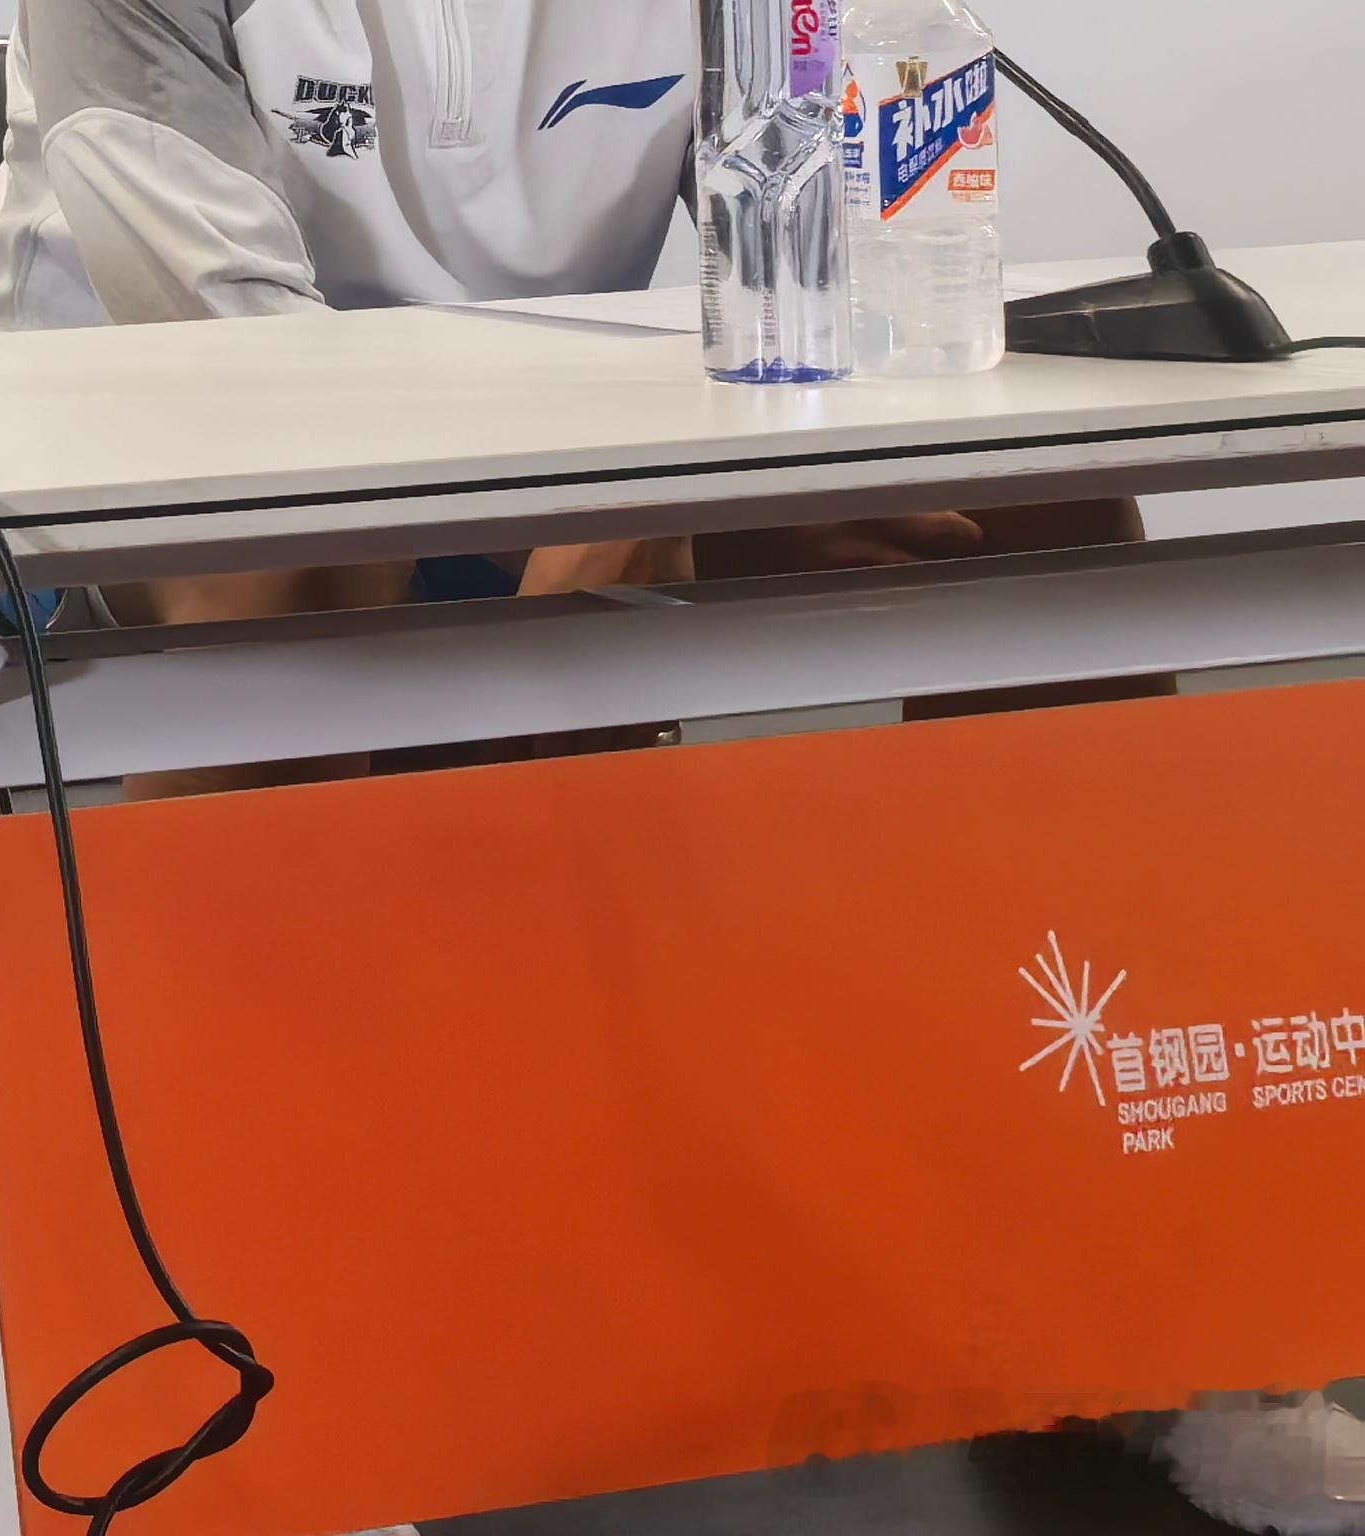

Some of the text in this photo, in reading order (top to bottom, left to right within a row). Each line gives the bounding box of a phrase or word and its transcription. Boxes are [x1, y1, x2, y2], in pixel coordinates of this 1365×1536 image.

[893, 60, 988, 162] 补水啦
[1118, 1092, 1227, 1125] SHOUGANG
[1252, 1079, 1327, 1109] SPORTS
[1123, 1127, 1174, 1154] PARK
